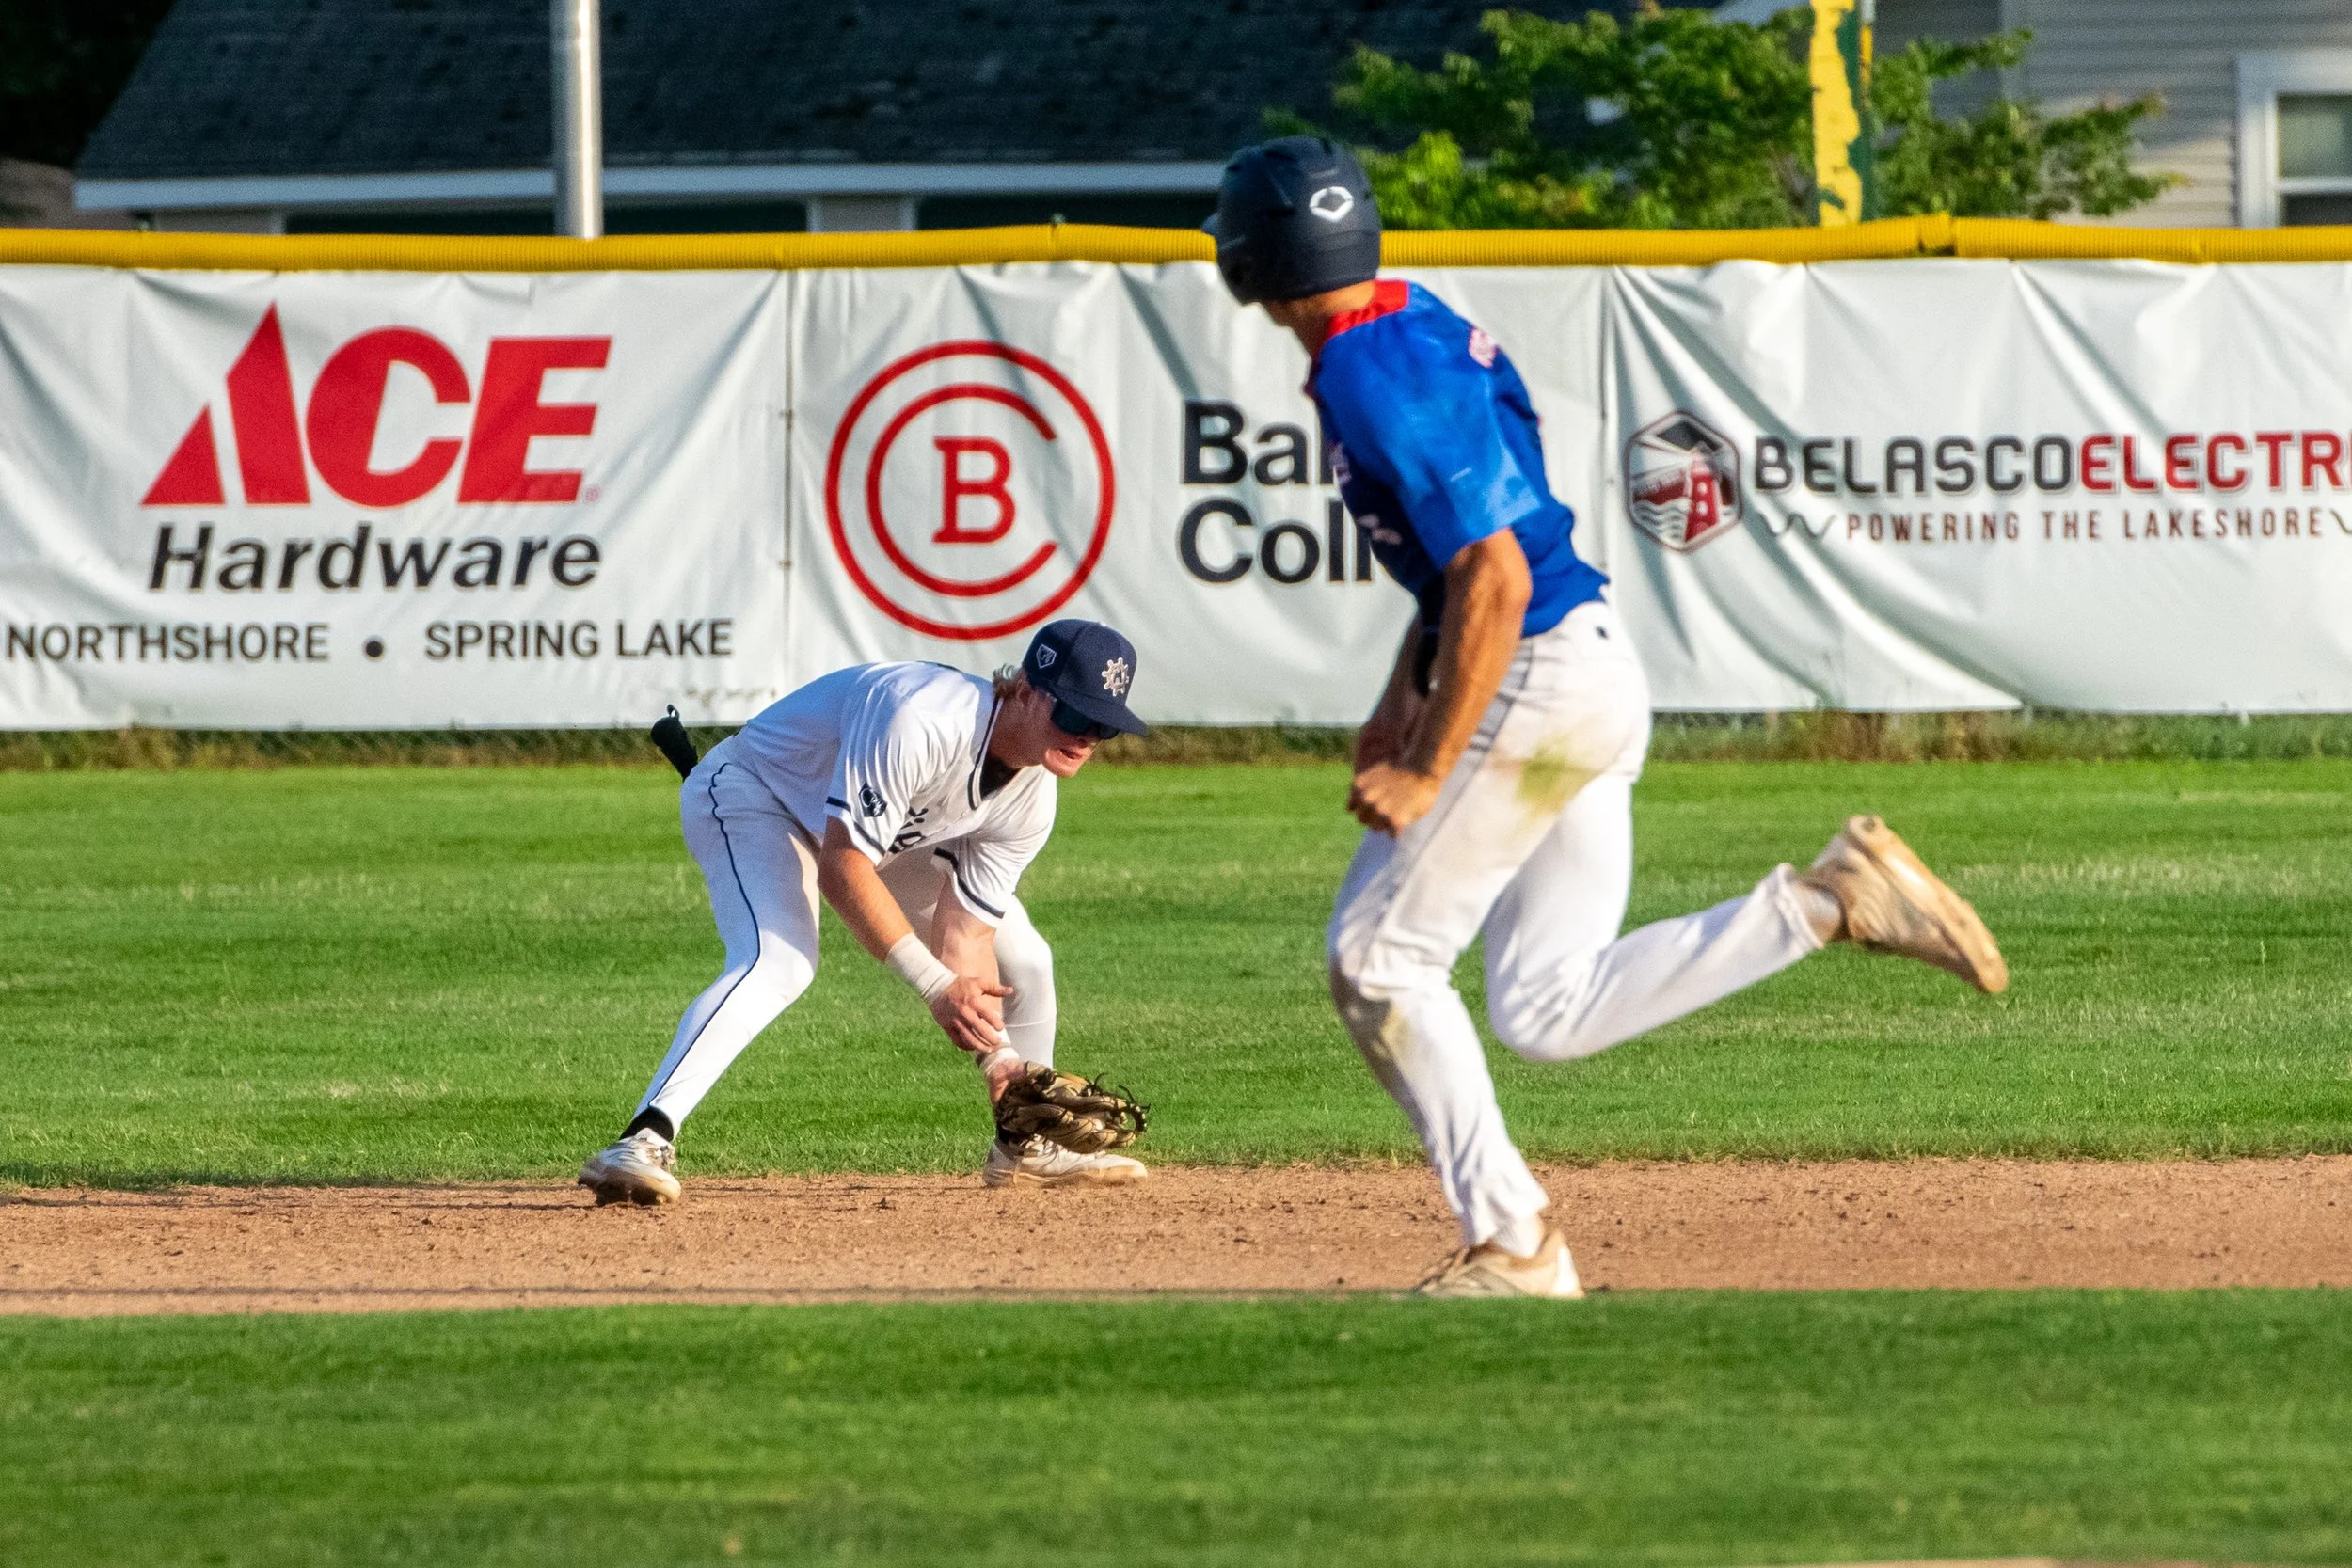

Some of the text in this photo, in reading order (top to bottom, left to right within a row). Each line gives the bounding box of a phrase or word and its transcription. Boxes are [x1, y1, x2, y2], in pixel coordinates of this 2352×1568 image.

[140, 303, 612, 510] ACE
[932, 436, 1018, 546] B
[149, 524, 601, 591] Hardware
[1846, 508, 2323, 543] POWERING THE LAKESHORE
[7, 621, 733, 662] NORTHSHORE SPRING LAKE
